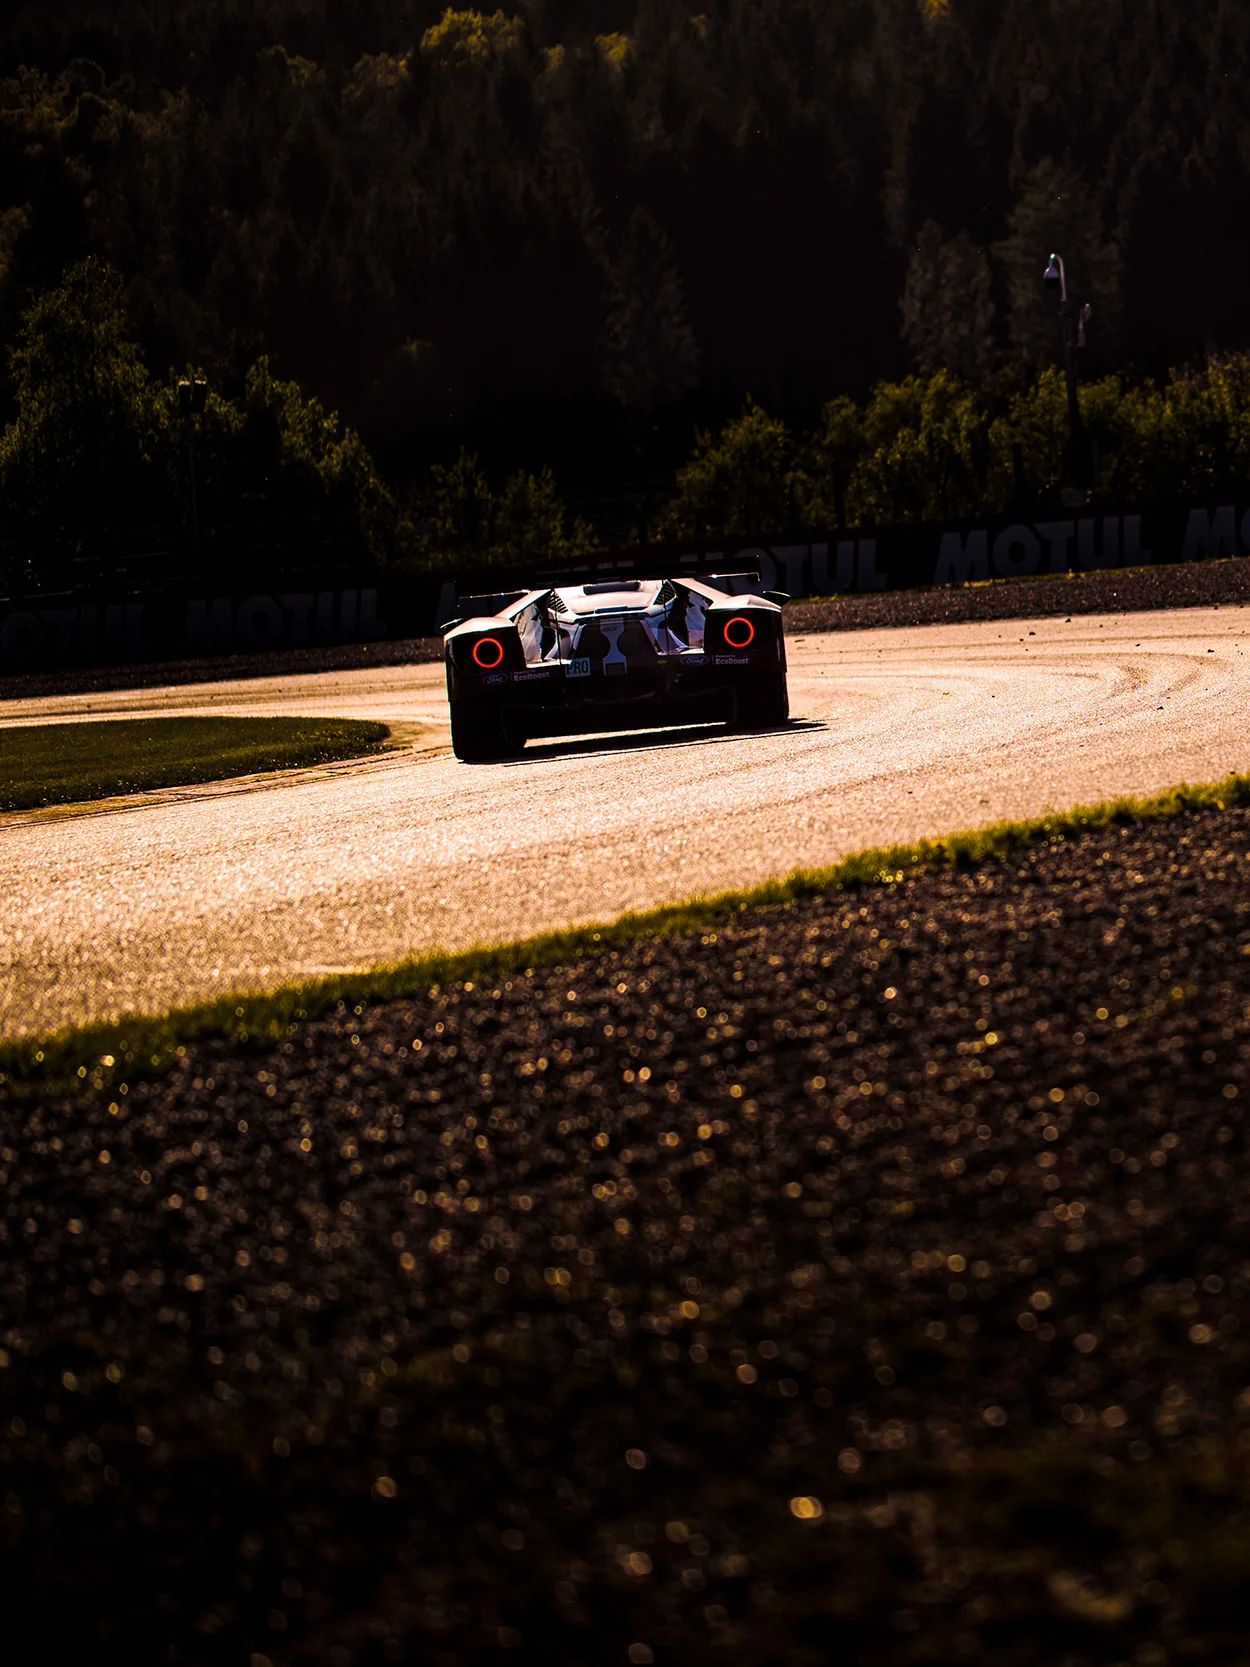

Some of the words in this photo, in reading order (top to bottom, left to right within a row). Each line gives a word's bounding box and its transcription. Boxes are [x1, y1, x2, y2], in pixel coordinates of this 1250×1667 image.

[679, 538, 889, 601] OTUL
[932, 513, 1155, 586] MOTUL
[181, 588, 389, 651] MOTUL
[566, 660, 589, 675] PRO
[715, 657, 749, 665] EcoBoost
